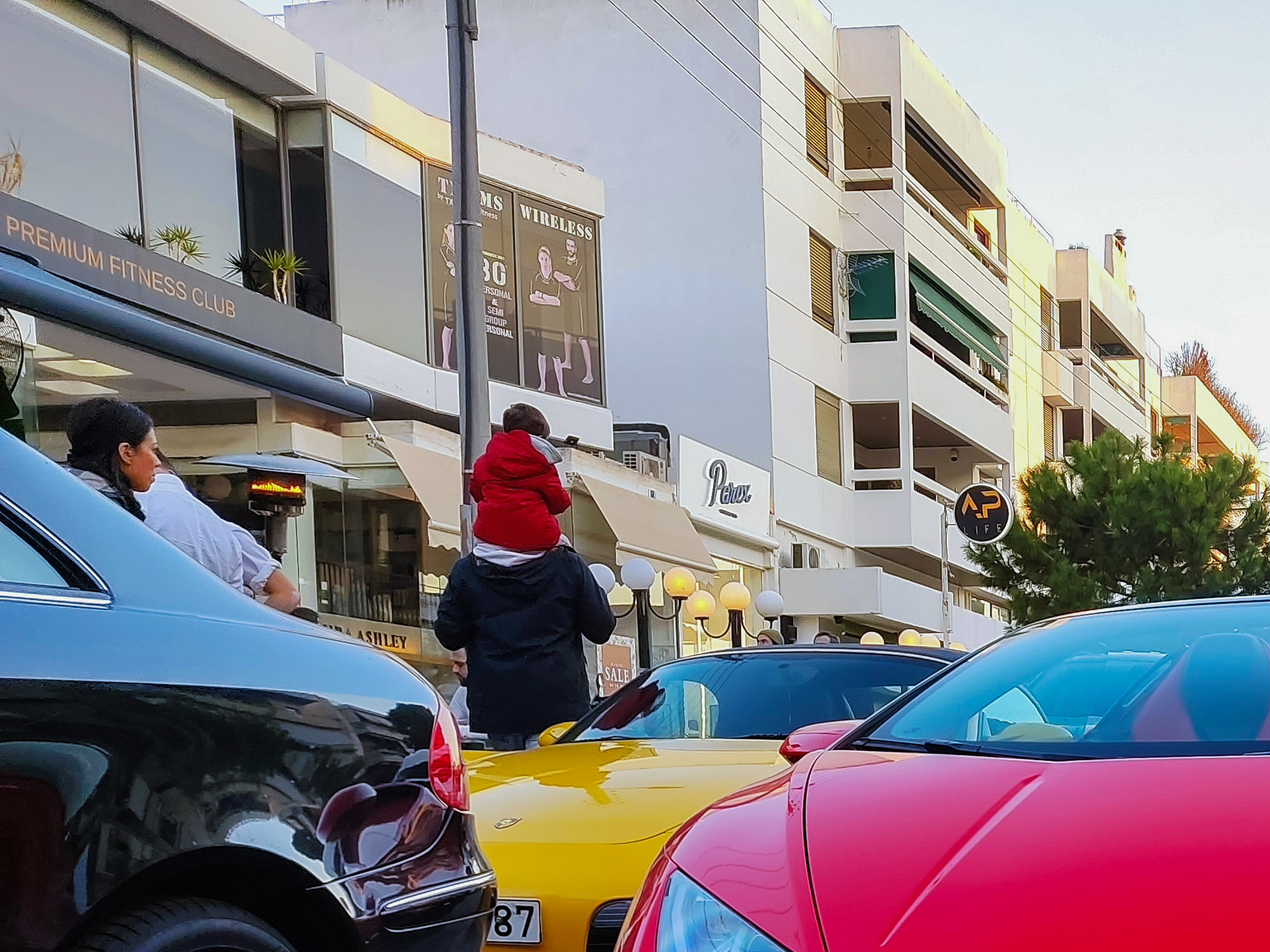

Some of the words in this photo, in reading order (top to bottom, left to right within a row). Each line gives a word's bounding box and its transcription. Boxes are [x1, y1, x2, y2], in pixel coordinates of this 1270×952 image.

[520, 203, 593, 241] WIRELESS
[6, 215, 104, 270] PREMIUM
[109, 255, 187, 301] FITNESS
[192, 288, 236, 318] CLUB
[484, 285, 513, 301] ERSONAL
[487, 305, 504, 317] SEMI
[485, 315, 507, 328] GROUP
[485, 324, 514, 339] ERSONAL
[963, 523, 1002, 536] LIFE
[357, 629, 407, 650] ASHLEY
[605, 666, 630, 684] SALE
